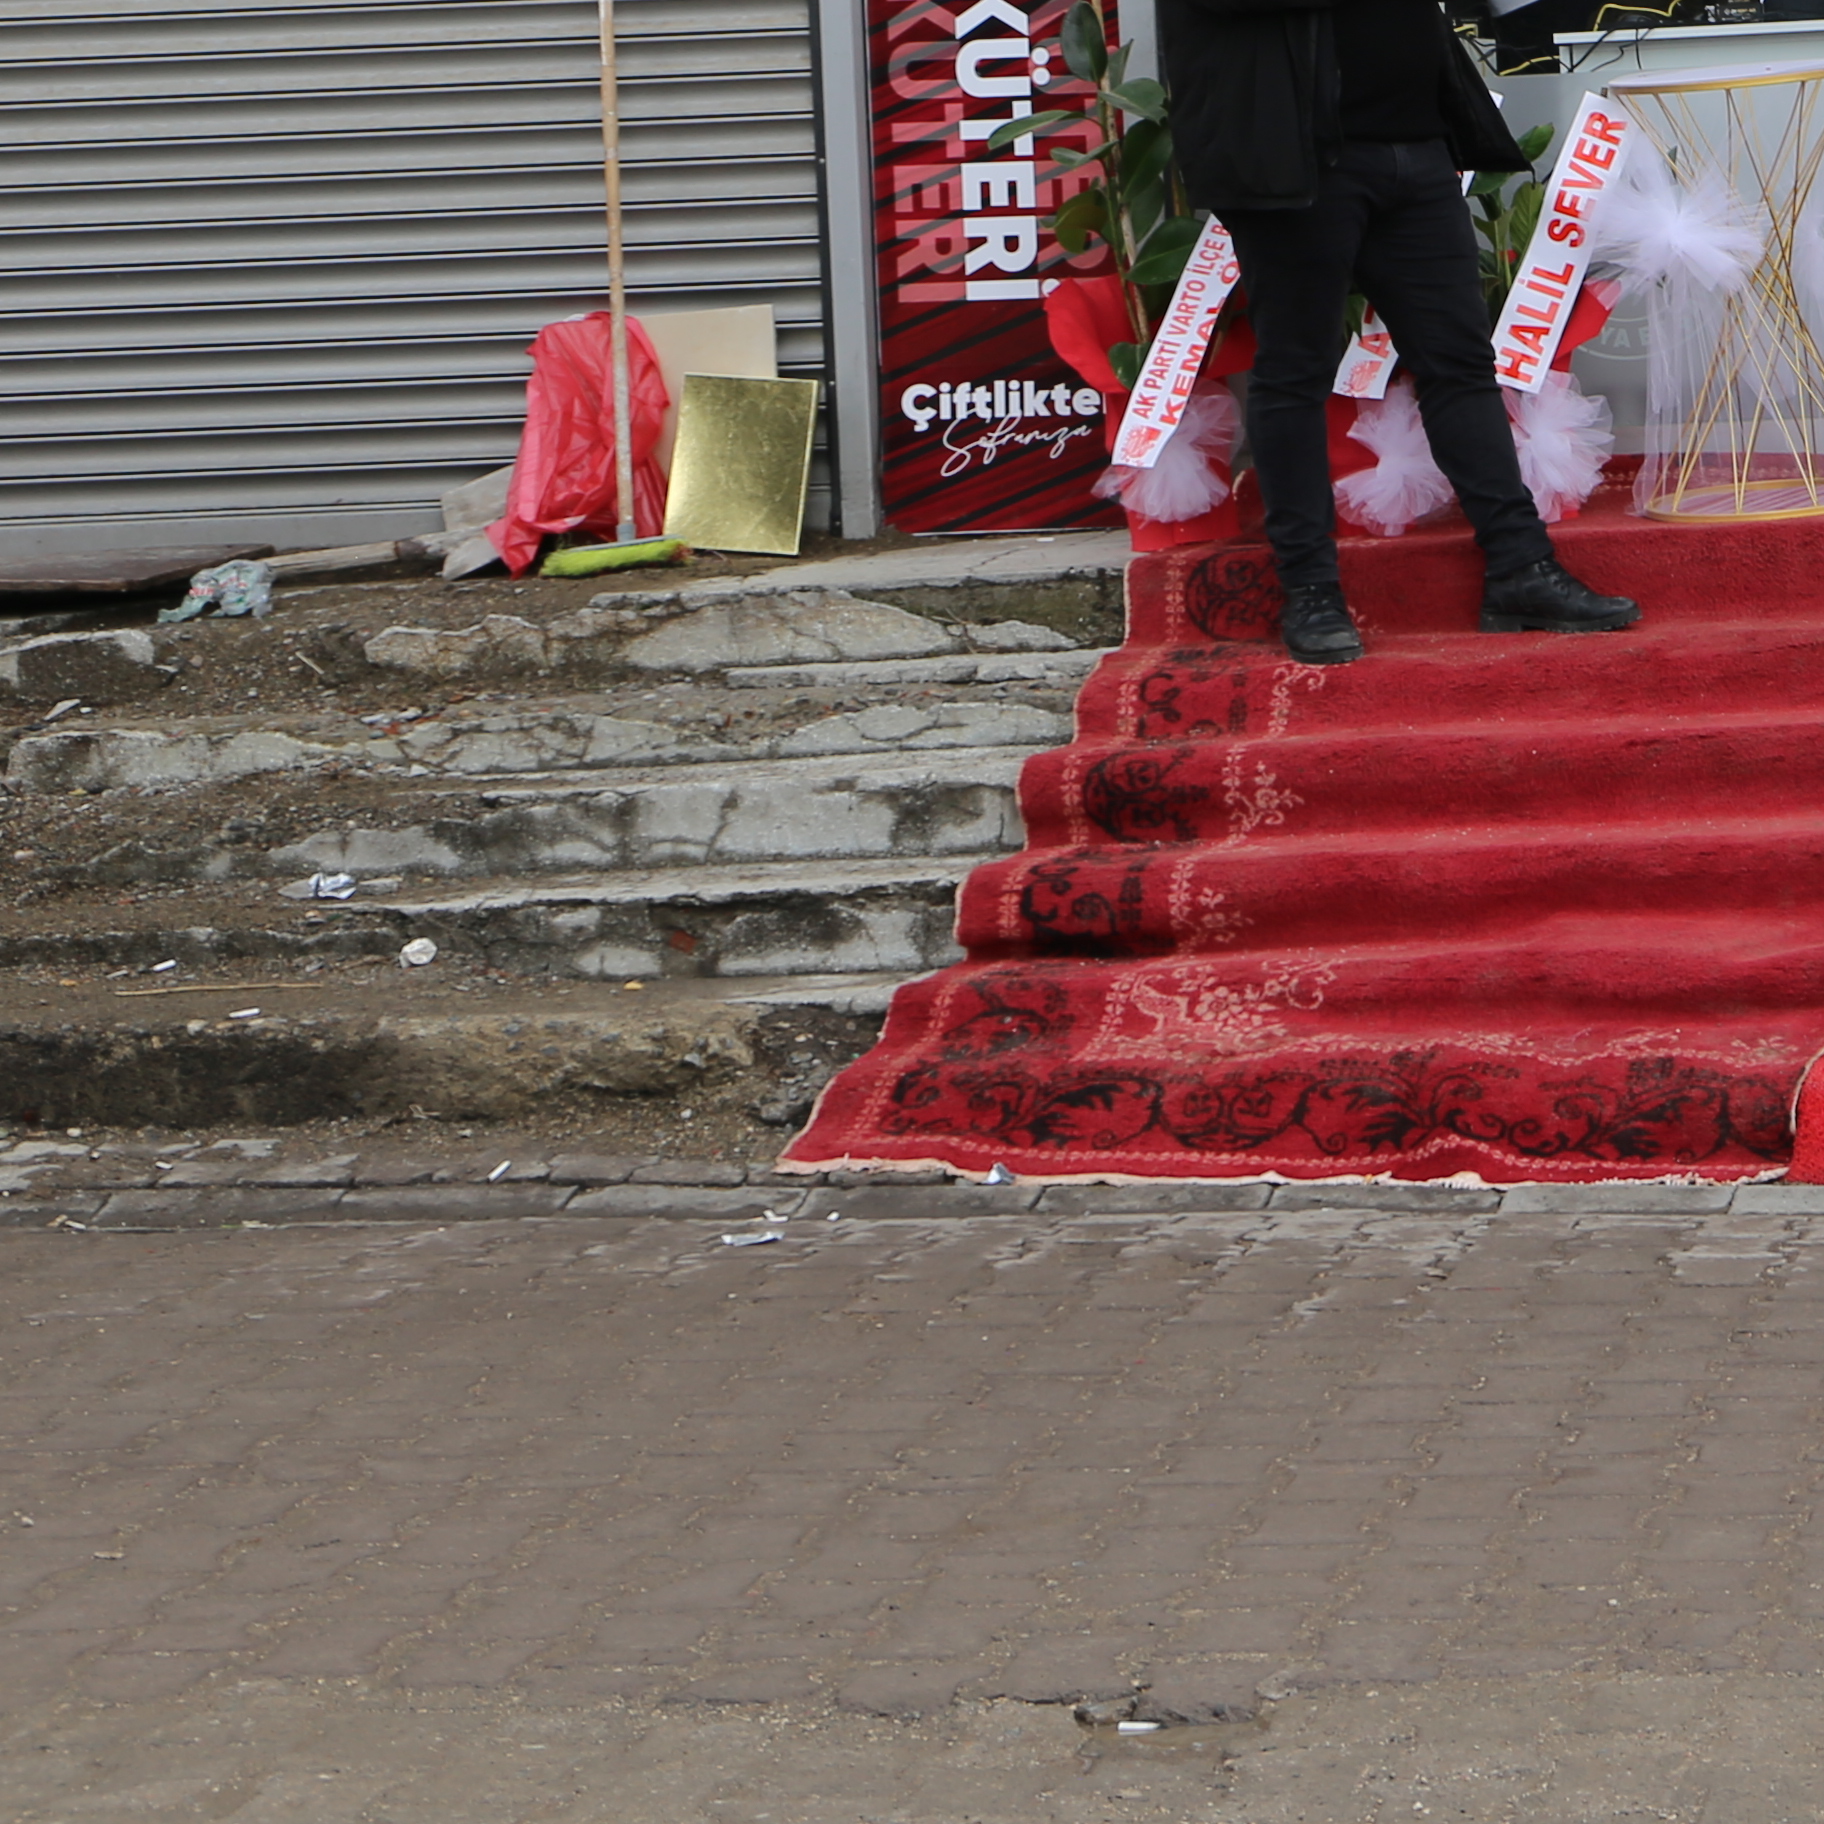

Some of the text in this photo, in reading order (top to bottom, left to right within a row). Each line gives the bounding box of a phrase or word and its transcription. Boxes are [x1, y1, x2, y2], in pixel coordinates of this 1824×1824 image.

[1494, 262, 1577, 385] HALİL
[1547, 110, 1629, 249] SEVER
[1166, 279, 1207, 337] VARTO
[1144, 338, 1182, 390] PARTİ
[901, 380, 1108, 432] Çiftlikte
[1132, 393, 1158, 419] AK
